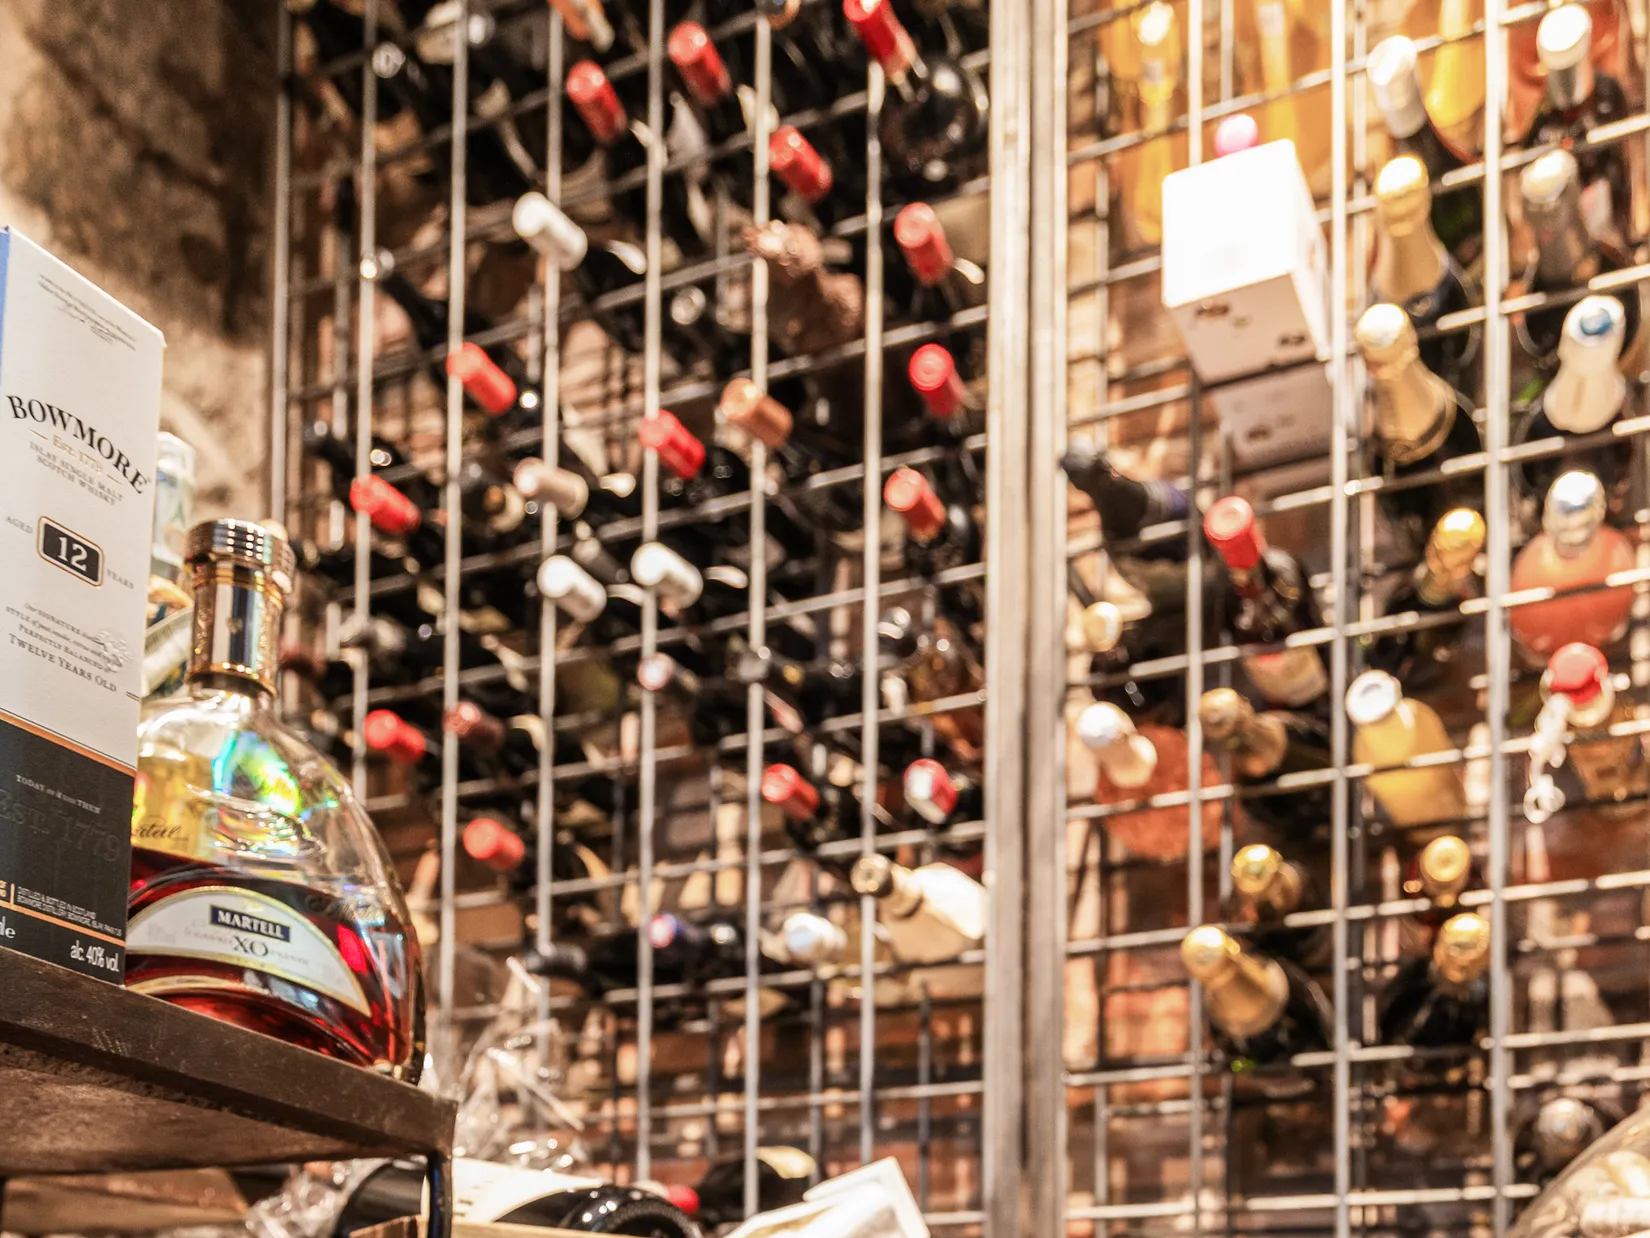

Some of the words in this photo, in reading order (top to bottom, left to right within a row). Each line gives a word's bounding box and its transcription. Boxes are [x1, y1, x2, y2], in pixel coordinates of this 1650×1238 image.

[6, 395, 148, 494] BOWMORE
[29, 441, 57, 463] ISLAY
[60, 459, 95, 486] SINGLE
[98, 482, 124, 502] MALT
[37, 455, 75, 482] SCOTCH
[6, 515, 33, 534] AGED
[57, 536, 88, 572] 12
[106, 568, 134, 589] YEARS
[9, 633, 55, 663] TWELVE
[58, 656, 92, 681] YEARS
[95, 675, 117, 692] OLD
[217, 909, 285, 939] MARTELL
[233, 934, 269, 958] XO
[70, 940, 86, 962] alc.
[86, 945, 105, 968] 40%
[105, 953, 120, 973] vol.
